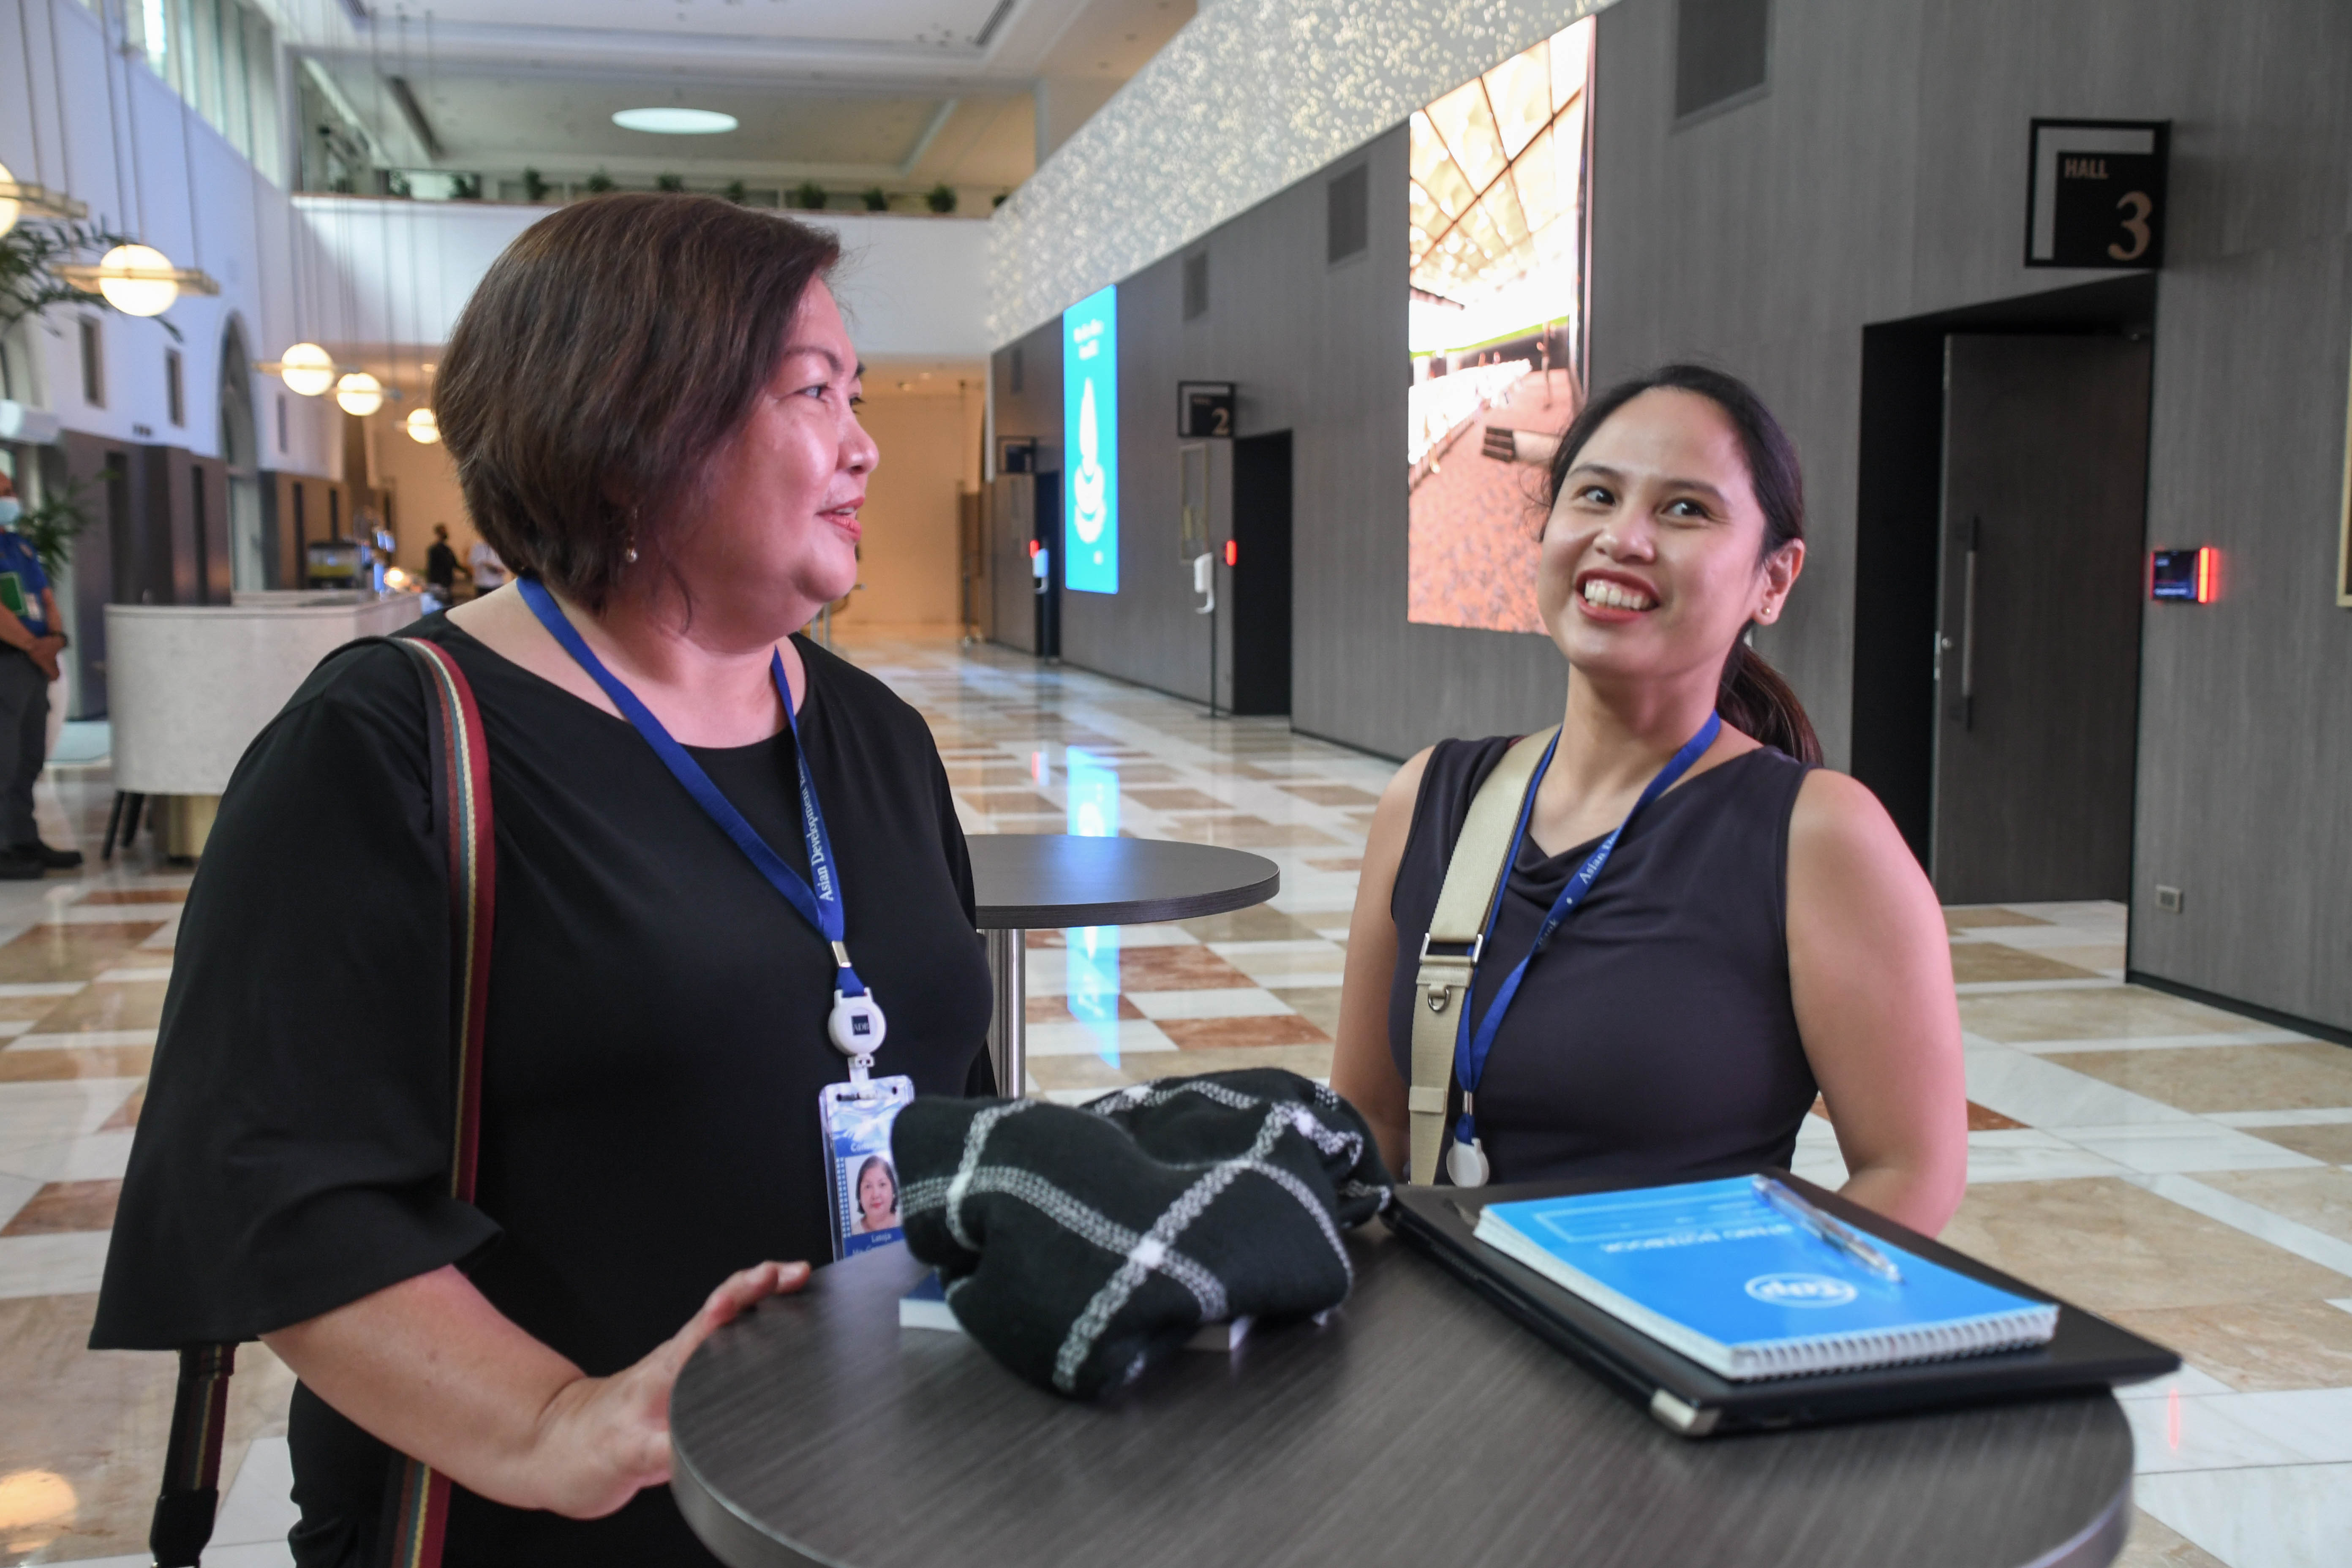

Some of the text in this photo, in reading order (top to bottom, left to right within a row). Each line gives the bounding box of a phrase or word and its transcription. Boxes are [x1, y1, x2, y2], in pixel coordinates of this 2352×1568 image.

[2064, 158, 2109, 180] HALL
[2108, 191, 2153, 261] 3
[1211, 407, 1229, 436] 2
[801, 789, 826, 866] Development
[817, 865, 834, 902] Asian
[1579, 852, 1606, 885] Asian
